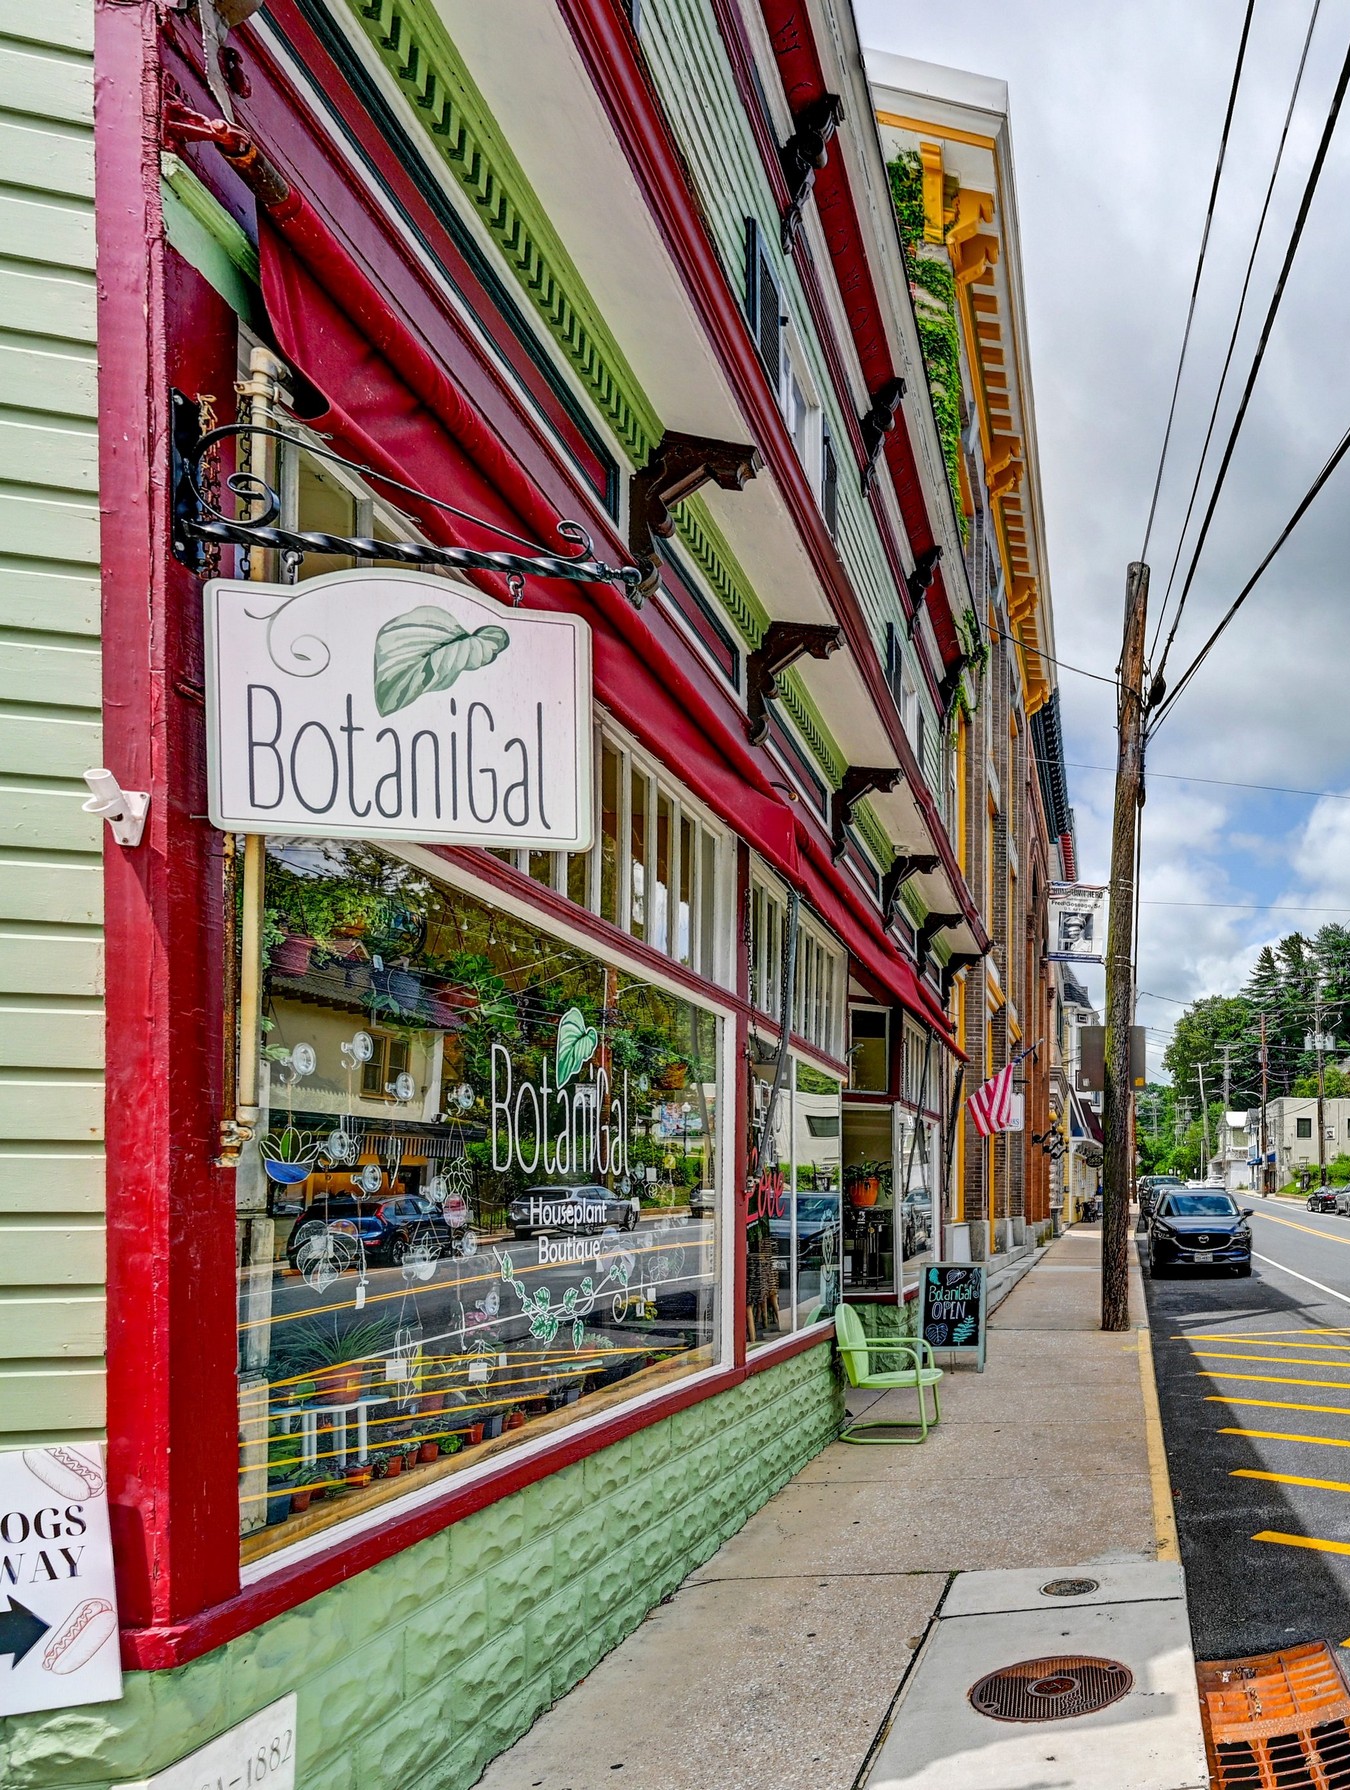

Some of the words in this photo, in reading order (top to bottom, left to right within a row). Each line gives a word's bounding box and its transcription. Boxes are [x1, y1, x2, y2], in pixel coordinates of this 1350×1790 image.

[247, 684, 552, 830] BotaniGal
[491, 1043, 630, 1176] BotaniGal
[530, 1196, 608, 1232] Houseplant
[538, 1235, 600, 1265] Boutique
[931, 1301, 966, 1320] OPEN
